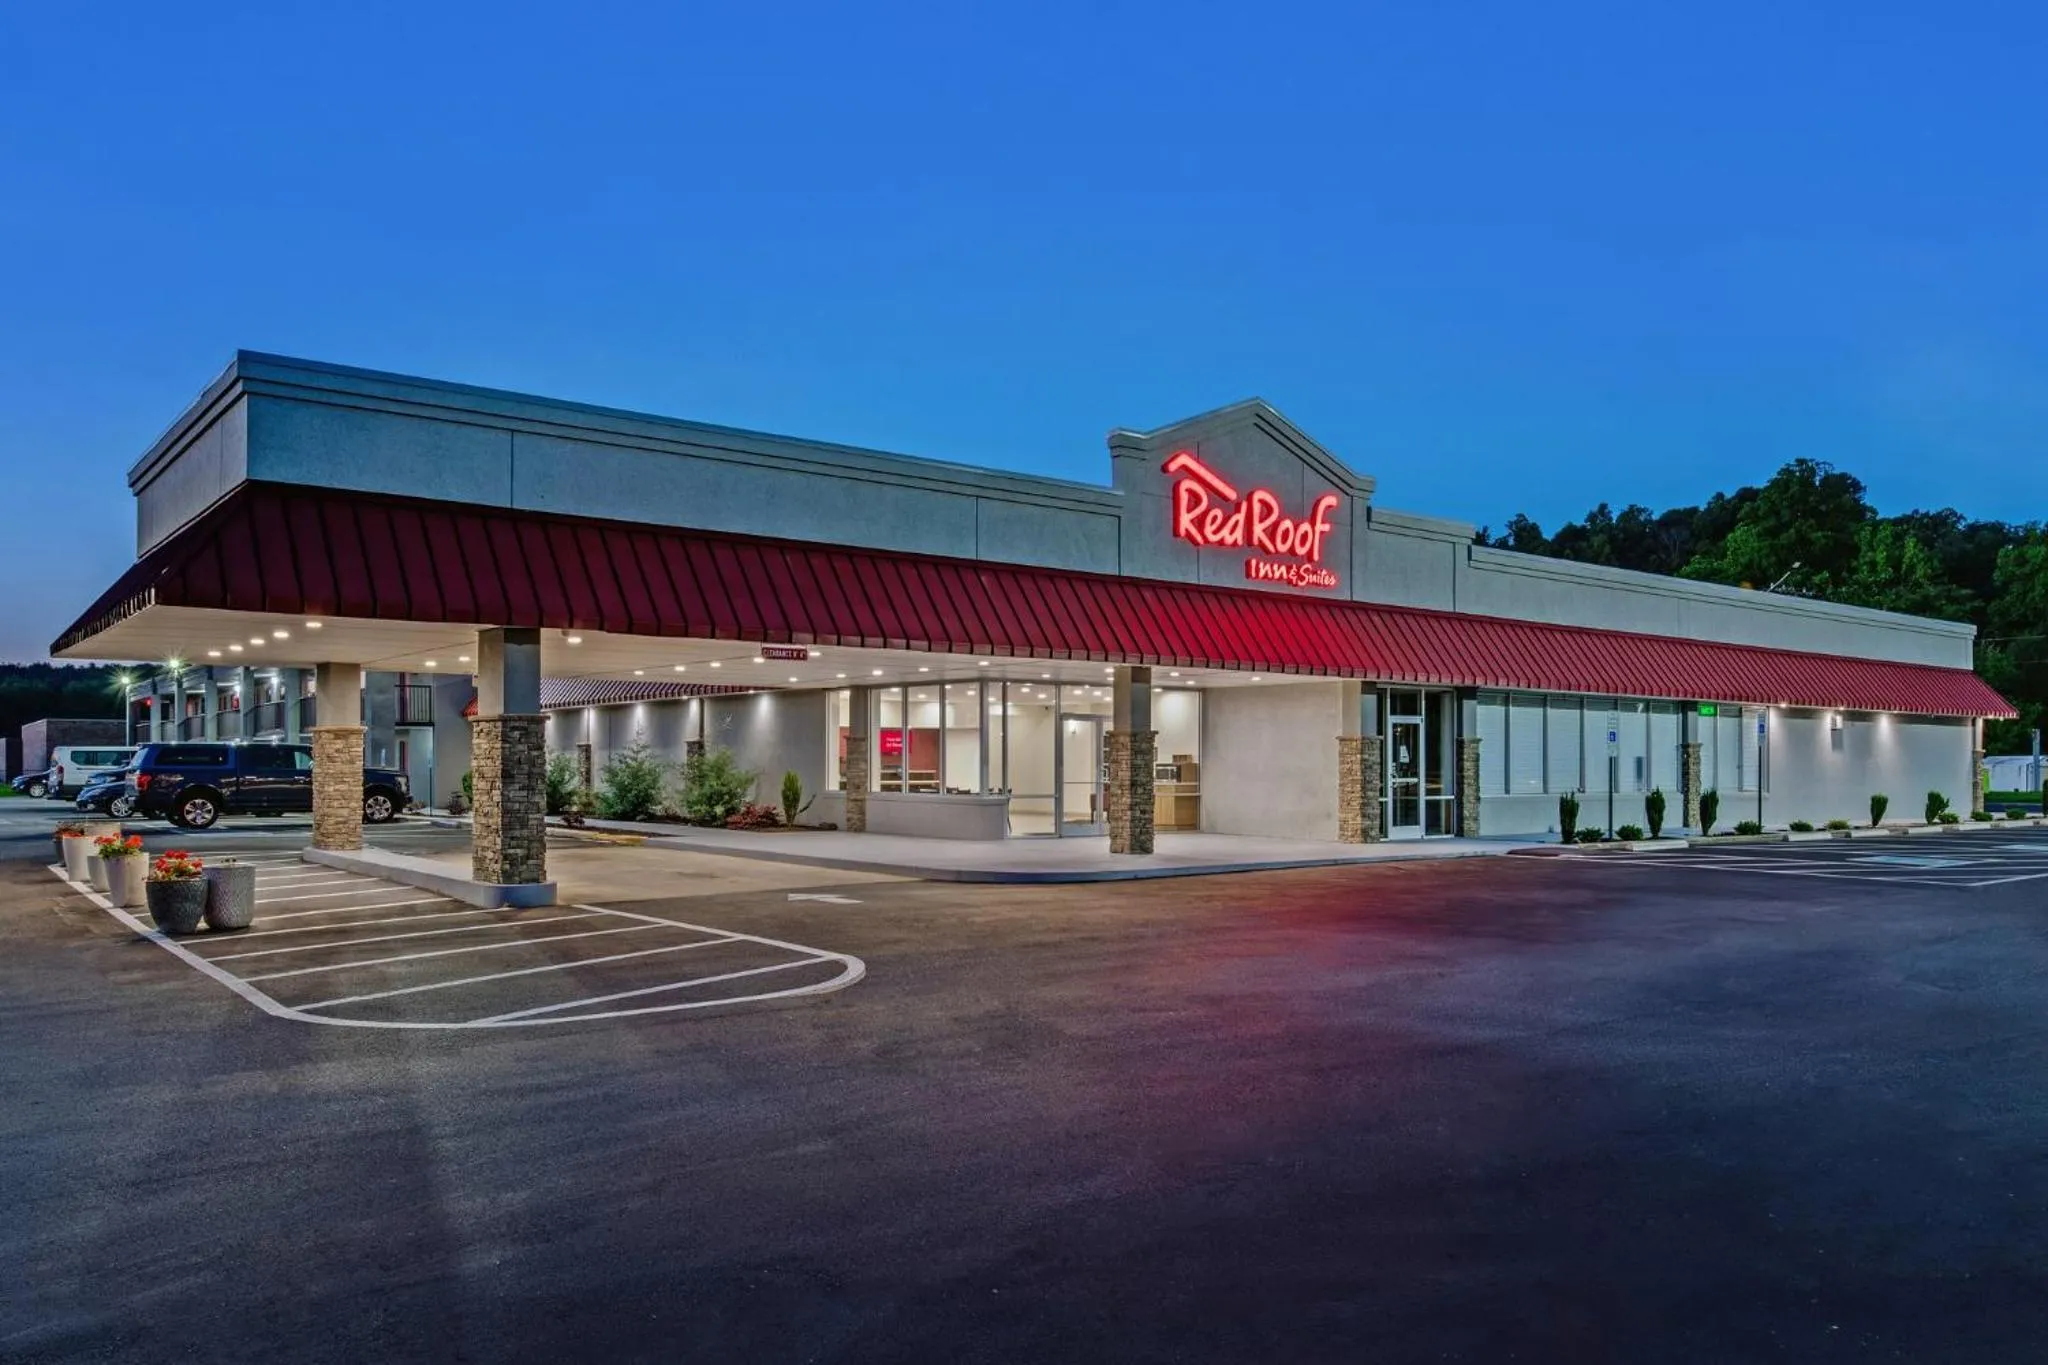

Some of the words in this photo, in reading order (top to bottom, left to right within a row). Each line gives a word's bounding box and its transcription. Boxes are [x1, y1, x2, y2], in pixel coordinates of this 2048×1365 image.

[1173, 478, 1248, 546] Red
[1247, 489, 1338, 563] Roof
[1246, 558, 1288, 580] Inn
[1298, 563, 1337, 586] Suites
